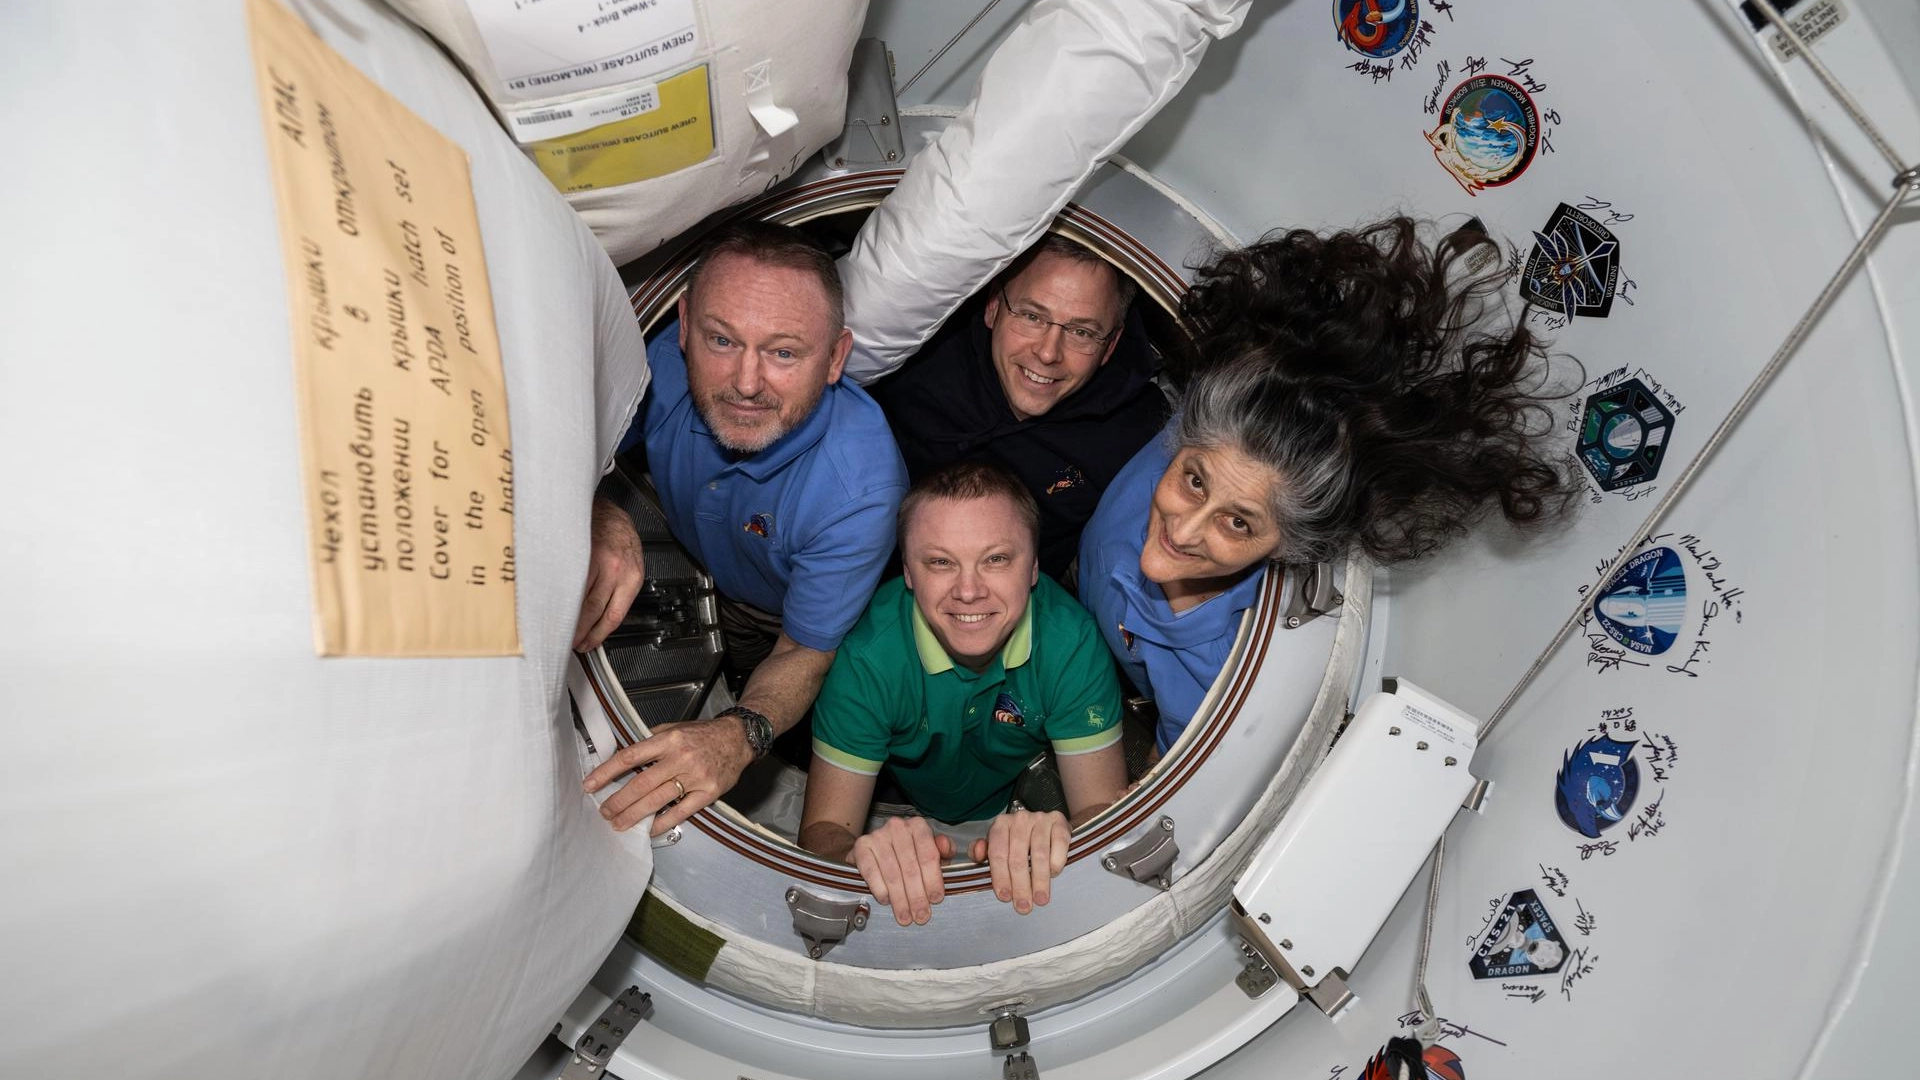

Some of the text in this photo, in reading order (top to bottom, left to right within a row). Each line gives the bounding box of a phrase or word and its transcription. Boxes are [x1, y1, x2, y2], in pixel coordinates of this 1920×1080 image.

[593, 12, 621, 27] Brick
[1802, 0, 1829, 21] CELL
[1814, 5, 1839, 26] LINE
[577, 24, 585, 33] 4
[509, 31, 695, 90] CREW SUITCASE (WILMORE) B1
[1445, 86, 1469, 115] БОРИСОВ
[1491, 79, 1527, 104] MOGENSEN
[622, 127, 670, 144] SUITCASE
[670, 116, 698, 131] CREW
[1525, 106, 1537, 147] MOGHBELI
[316, 101, 360, 238] открытом
[1565, 207, 1611, 239] CRISTOFORETTI
[1525, 258, 1536, 279] HINES
[1605, 265, 1618, 298] WATKINS
[268, 66, 343, 564] Чехол крышки АПАС
[385, 158, 453, 581] Cover for APDA hatch set
[384, 268, 417, 572] положении крышки
[433, 226, 491, 586] in the open position of
[350, 386, 387, 572] установить
[1614, 476, 1644, 488] SPACEX
[499, 448, 516, 584] the hatch
[1603, 567, 1629, 592] SPACEX
[1628, 549, 1664, 569] DRAGON
[1602, 618, 1653, 653] NASA CRS-22
[1530, 899, 1554, 934] SPACEX
[1487, 965, 1530, 976] DRAGON
